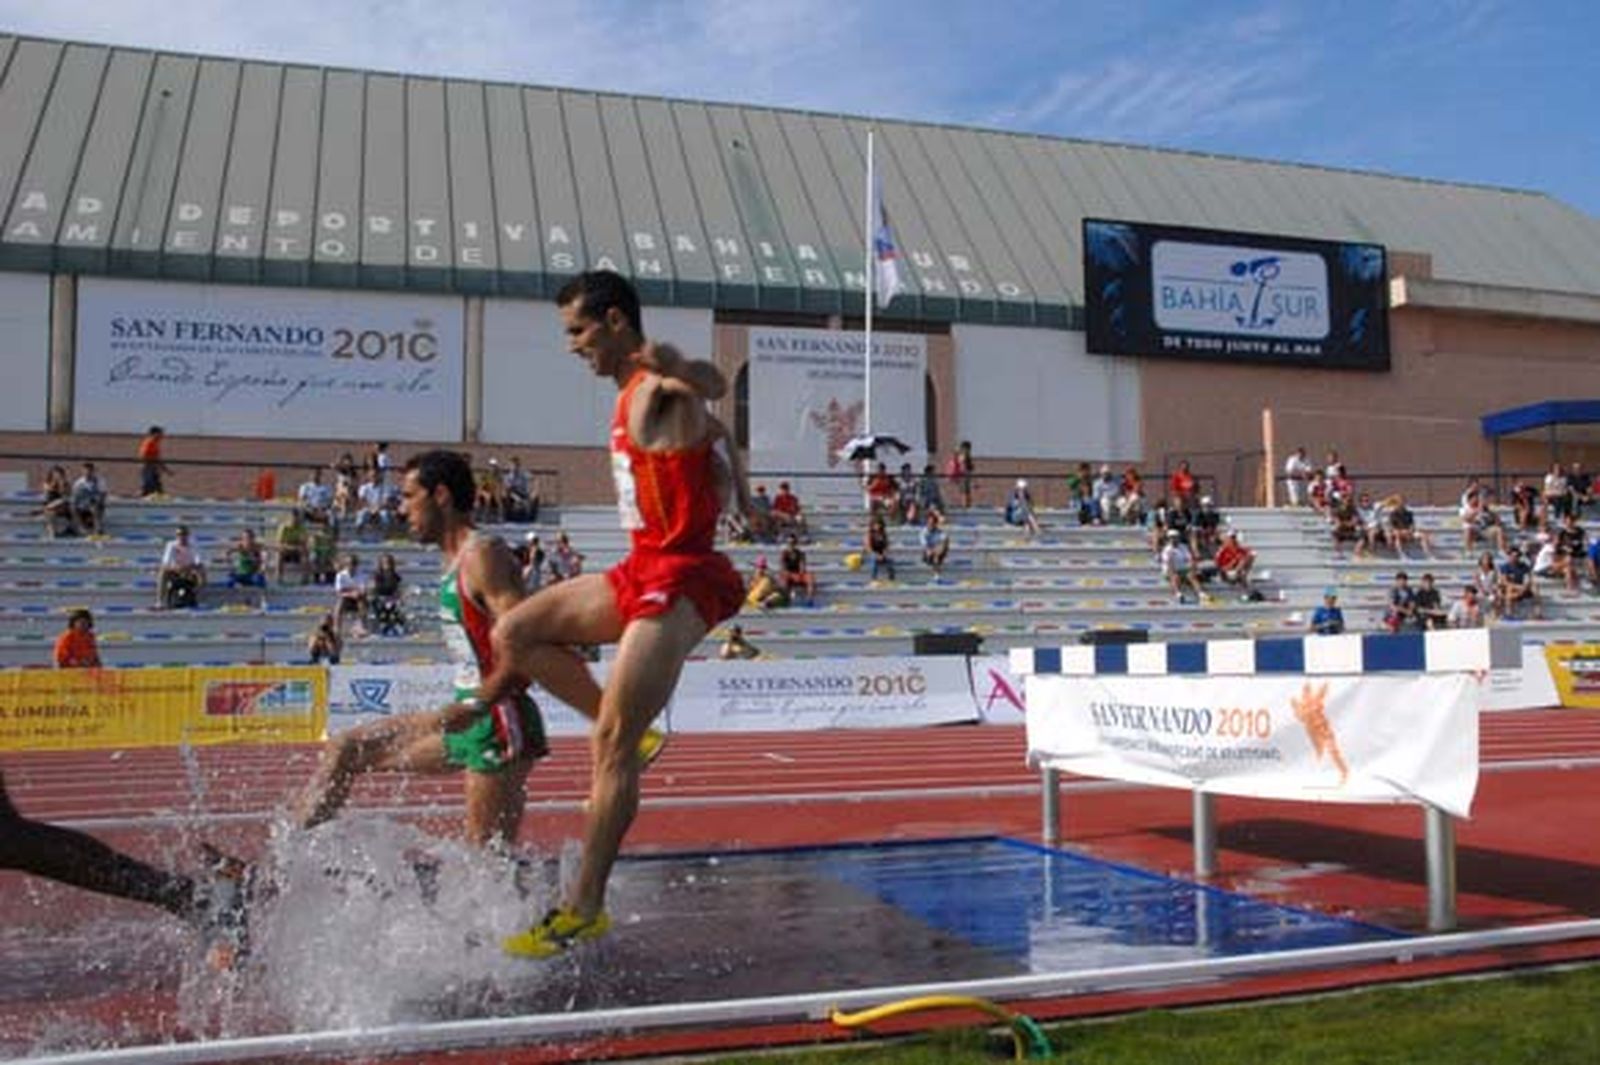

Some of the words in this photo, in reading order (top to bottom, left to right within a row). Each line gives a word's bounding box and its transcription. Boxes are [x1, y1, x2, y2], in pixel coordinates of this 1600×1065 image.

[178, 203, 569, 244] DEPORTIVA
[633, 232, 818, 260] BAHIA
[12, 221, 345, 257] AMIENTO
[415, 245, 482, 263] DE
[551, 252, 662, 274] SAN
[723, 263, 1020, 296] FERNNDO
[1272, 292, 1321, 319] SUR
[111, 317, 166, 339] SAN
[175, 321, 324, 346] FERNANDO
[756, 337, 787, 350] SAN
[1273, 344, 1290, 353] AL
[718, 678, 749, 690] SAN
[757, 677, 852, 690] FERNANDO
[1119, 704, 1213, 735] FERNANDO
[1217, 707, 1271, 739] 2010
